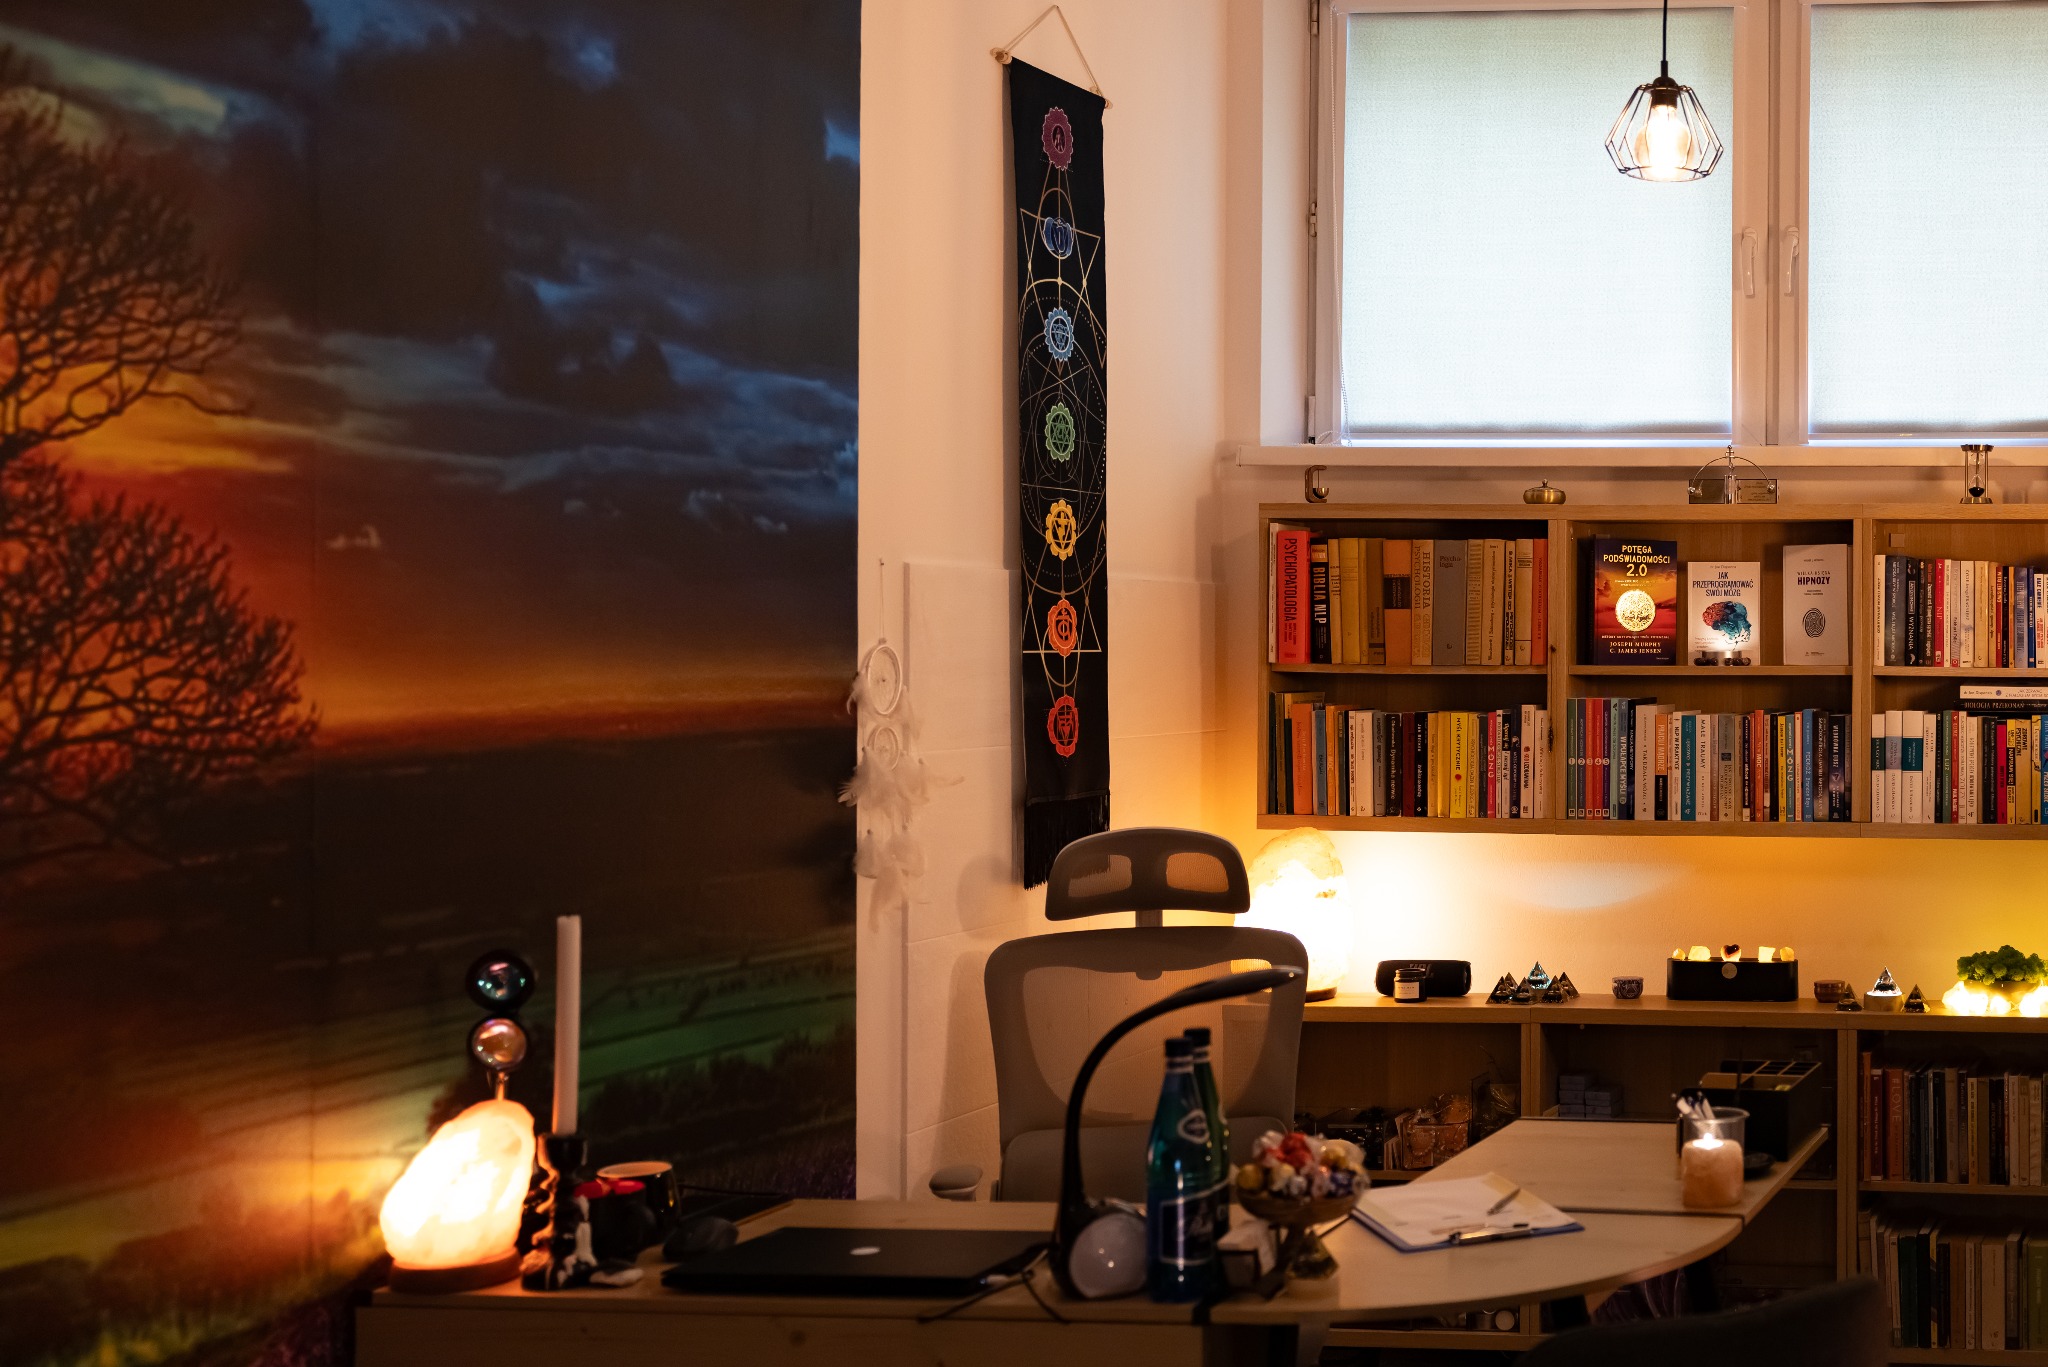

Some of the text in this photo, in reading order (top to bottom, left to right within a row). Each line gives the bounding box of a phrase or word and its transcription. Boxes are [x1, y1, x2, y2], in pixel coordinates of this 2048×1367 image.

[1622, 545, 1652, 554] POTĘGA
[1603, 554, 1670, 564] PODŚWIADOMOŚCI
[1626, 564, 1647, 577] 2.0
[1718, 571, 1729, 580] JAK
[1284, 538, 1298, 622] PSYCHOPATOLOGIA
[1313, 567, 1326, 601] BIBLIA
[1422, 551, 1431, 609] HISTORIA
[1797, 577, 1831, 585] HIPNOZY
[1314, 604, 1327, 624] NLP
